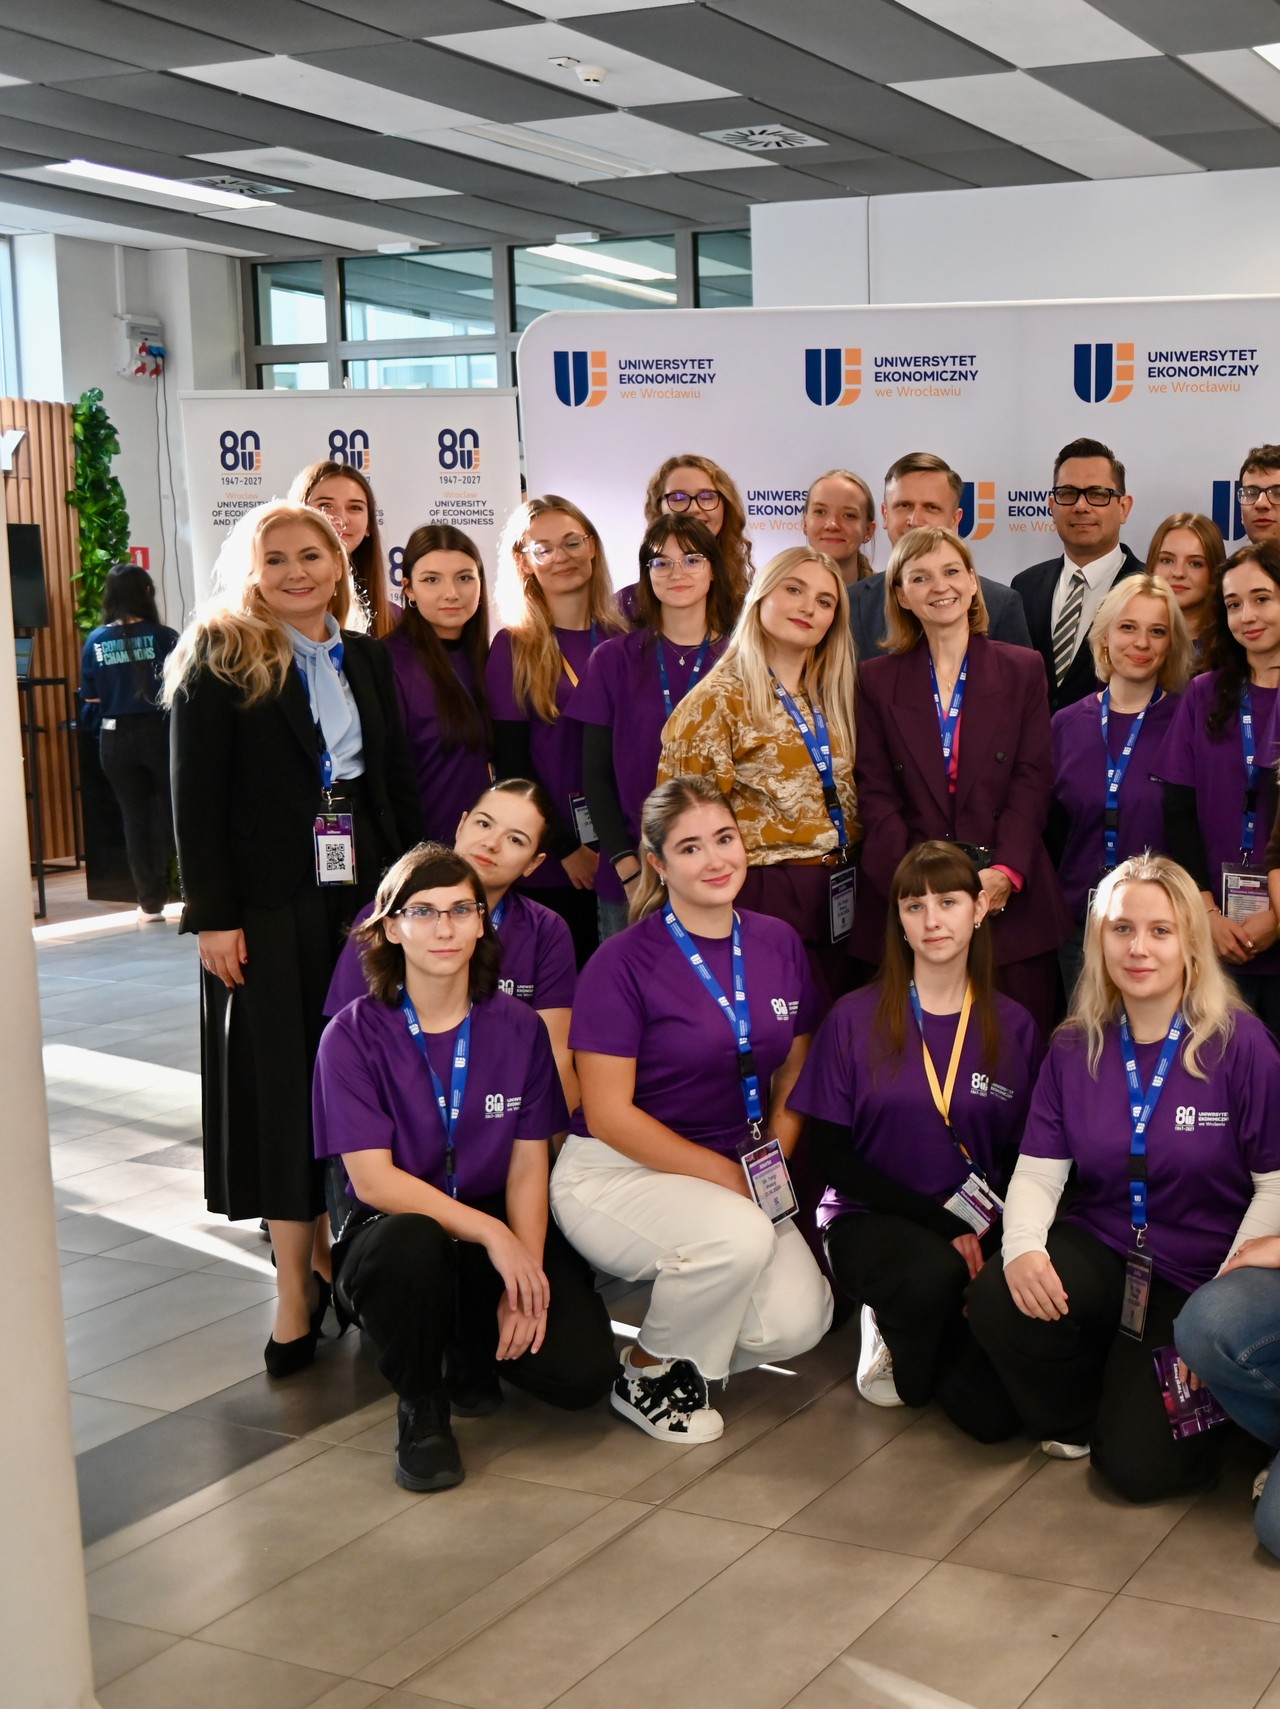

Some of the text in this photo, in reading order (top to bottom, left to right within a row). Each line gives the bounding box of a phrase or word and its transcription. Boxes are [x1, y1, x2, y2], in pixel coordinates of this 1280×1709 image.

[874, 355, 976, 367] UNIWERSYTET
[1148, 349, 1257, 362] UNIWERSYTET
[619, 359, 714, 370] UNIWERSYTET
[874, 370, 979, 382] EKONOMICZNY
[1148, 365, 1259, 378] EKONOMICZNY
[619, 373, 716, 384] EKONOMICZNY
[875, 385, 961, 397] we Wrocławiu
[1148, 380, 1241, 393] we Wrocławiu
[620, 388, 701, 399] we Wrocławiu
[0, 429, 26, 471] Y
[220, 430, 261, 472] 80
[438, 428, 480, 471] 80
[221, 477, 262, 486] 1947-2027
[439, 476, 481, 485] 1947-2027
[747, 490, 808, 501] UNIWERS
[434, 500, 487, 508] UNIVERSITY
[748, 505, 804, 516] EKONOM
[451, 518, 494, 526] BUSINESS
[750, 521, 766, 530] we
[1009, 522, 1027, 532] we
[103, 647, 156, 666] CHAMIONS
[1176, 1106, 1196, 1125] 80
